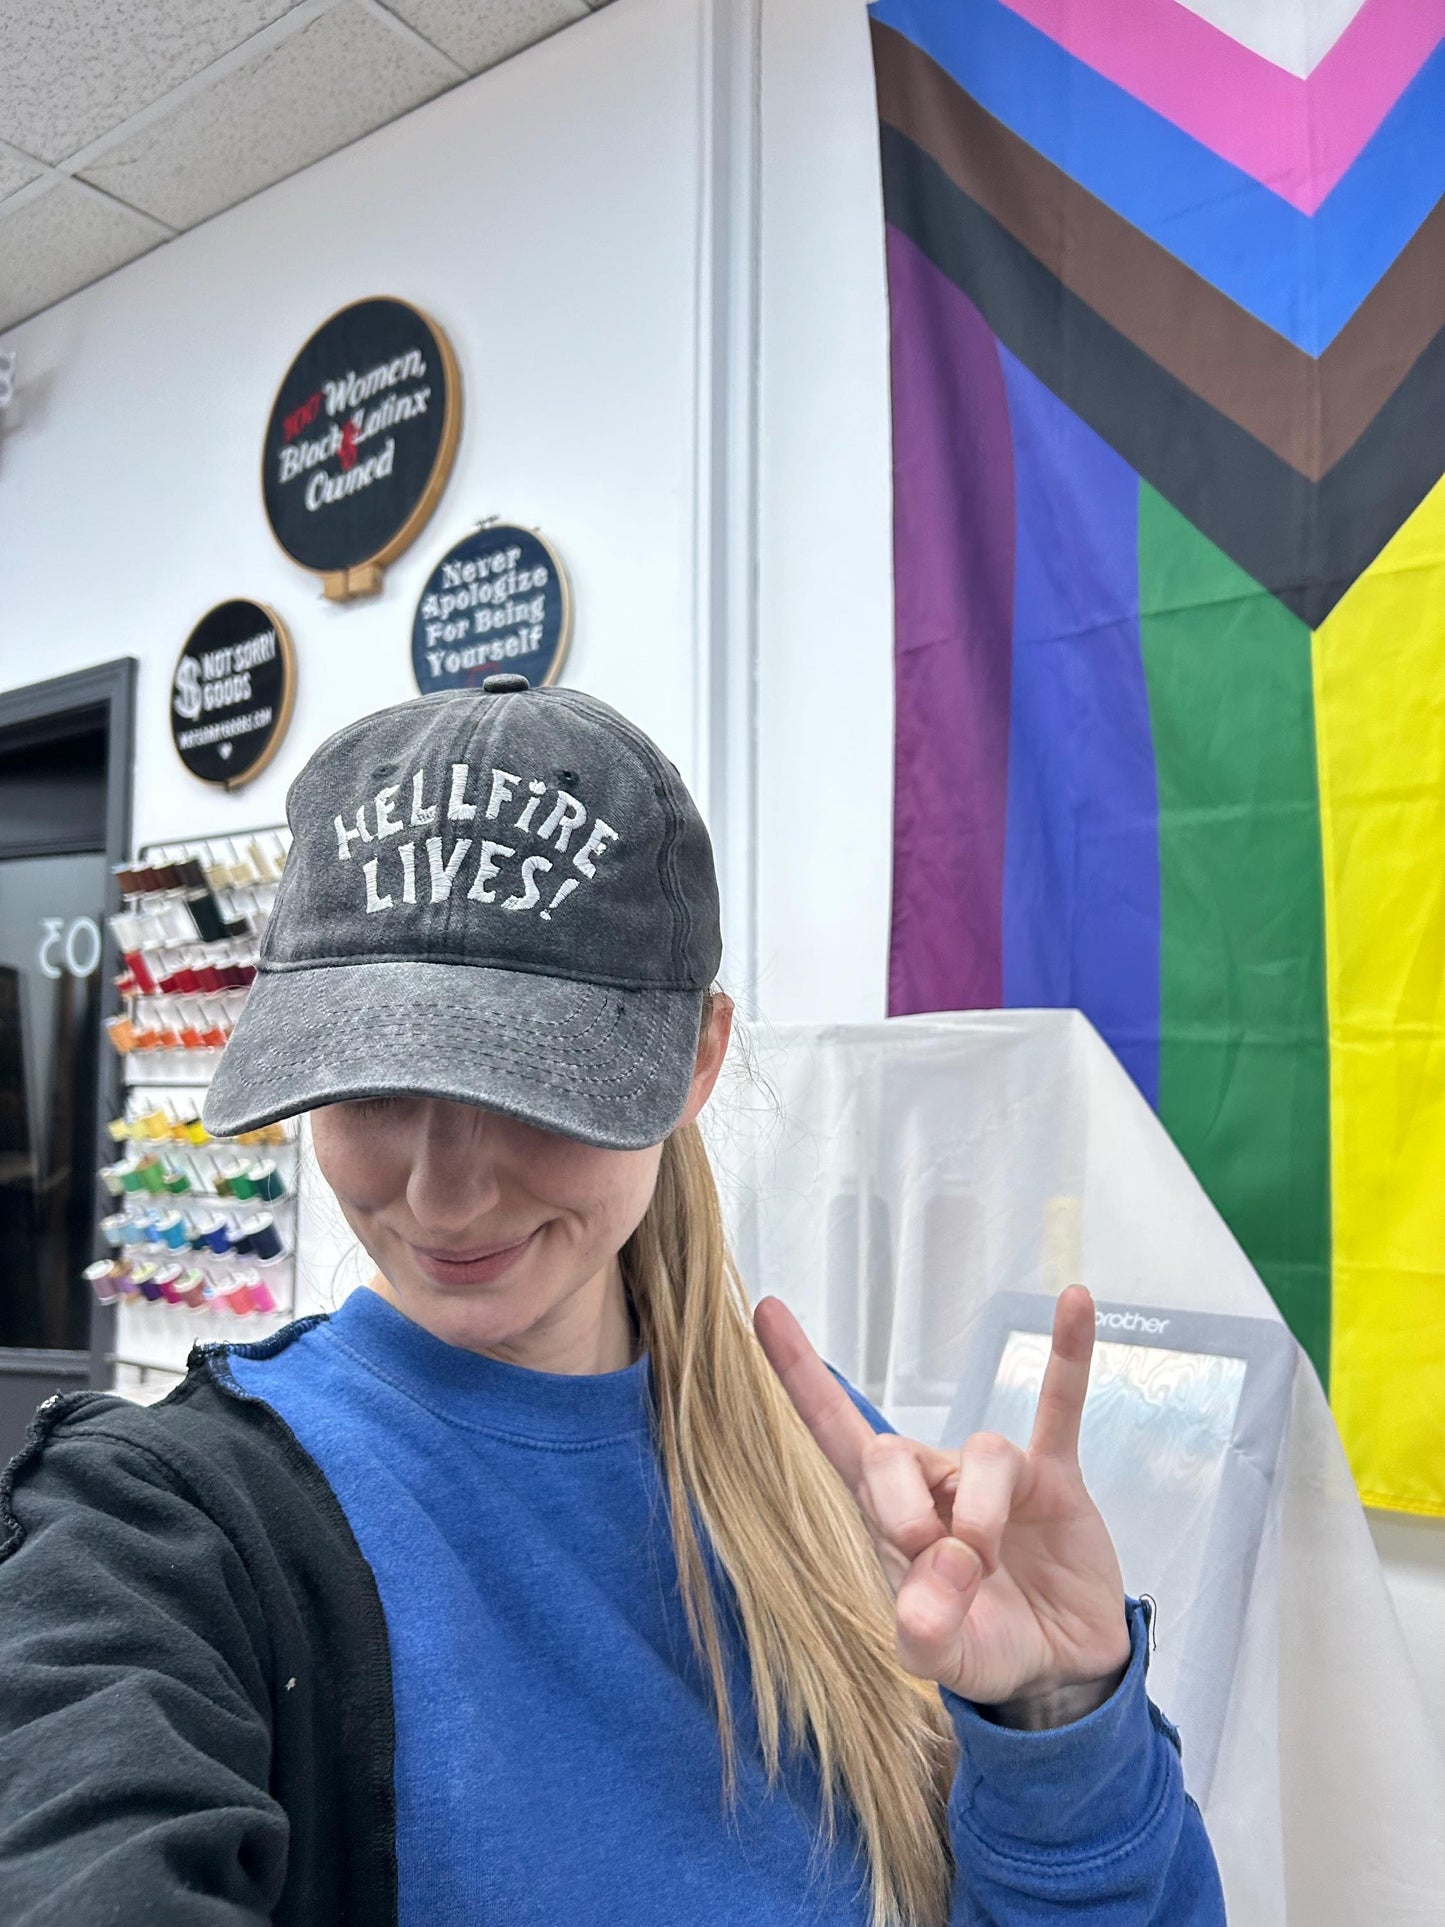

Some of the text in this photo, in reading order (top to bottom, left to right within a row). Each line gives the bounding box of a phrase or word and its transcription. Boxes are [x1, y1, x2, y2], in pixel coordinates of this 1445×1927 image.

[421, 565, 549, 620] Apologize
[442, 545, 522, 589] Never
[425, 594, 546, 647] For Being
[202, 629, 276, 682] NOT SORRY
[425, 624, 544, 678] Yourself
[203, 671, 252, 712] GOODS
[363, 836, 580, 921] LIVES!
